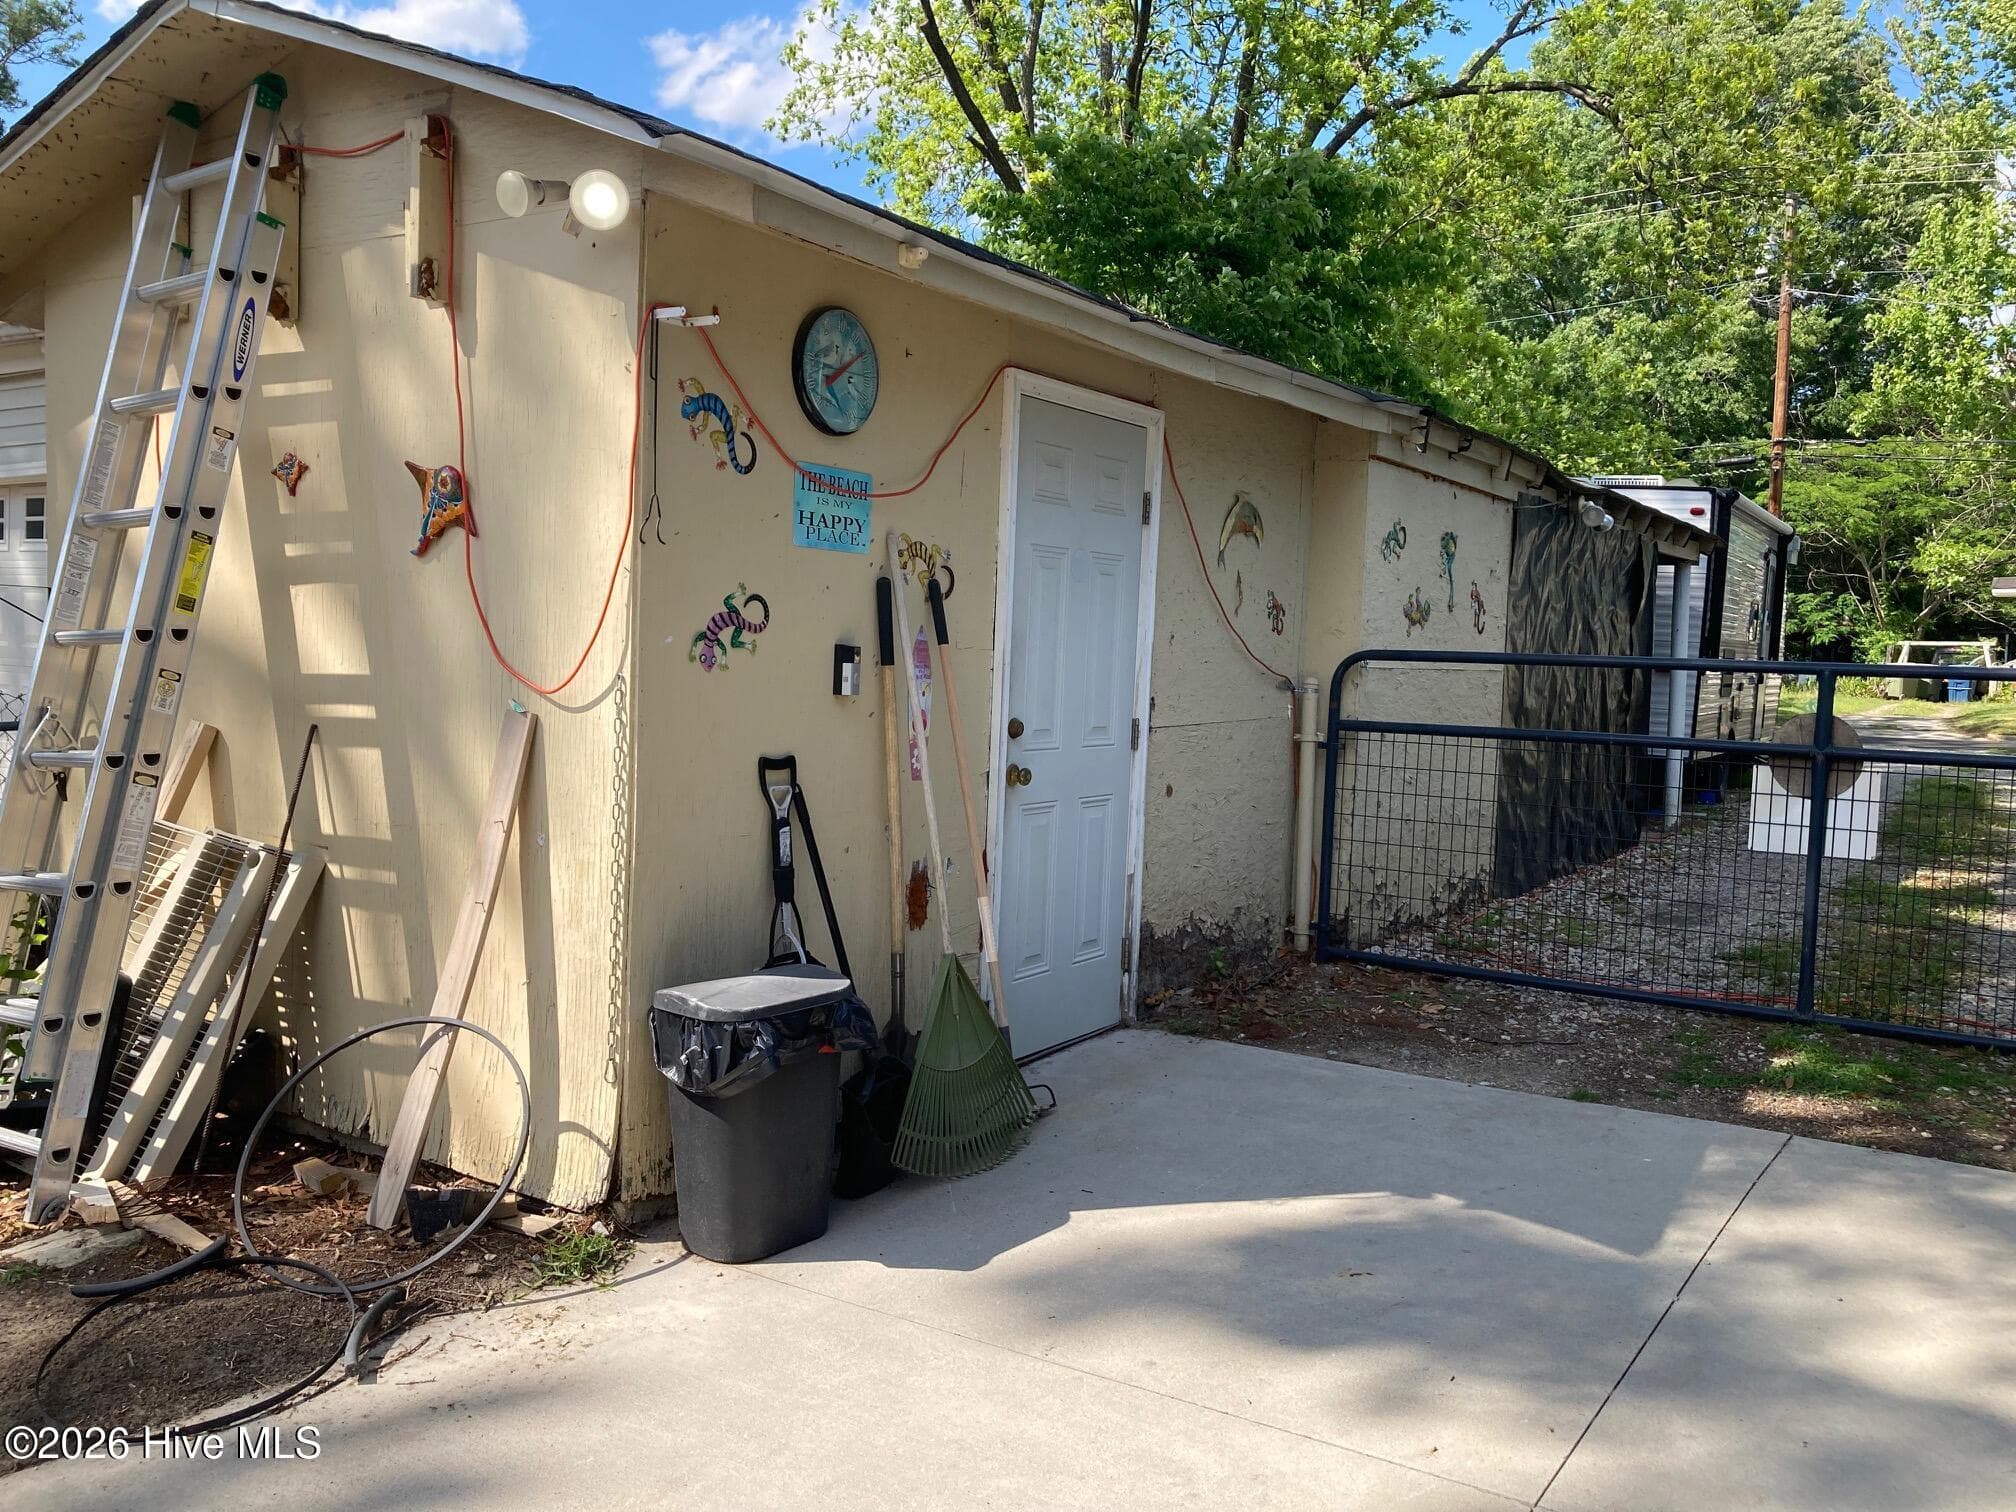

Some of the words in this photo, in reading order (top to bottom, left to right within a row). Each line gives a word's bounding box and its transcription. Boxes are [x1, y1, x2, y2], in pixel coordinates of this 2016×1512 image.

[236, 313, 252, 365] WERNER
[800, 470, 826, 494] THE
[828, 474, 869, 501] BEACH
[816, 496, 829, 506] IS
[833, 499, 853, 510] MY
[797, 509, 866, 534] HAPPY
[805, 525, 866, 547] PLACE.
